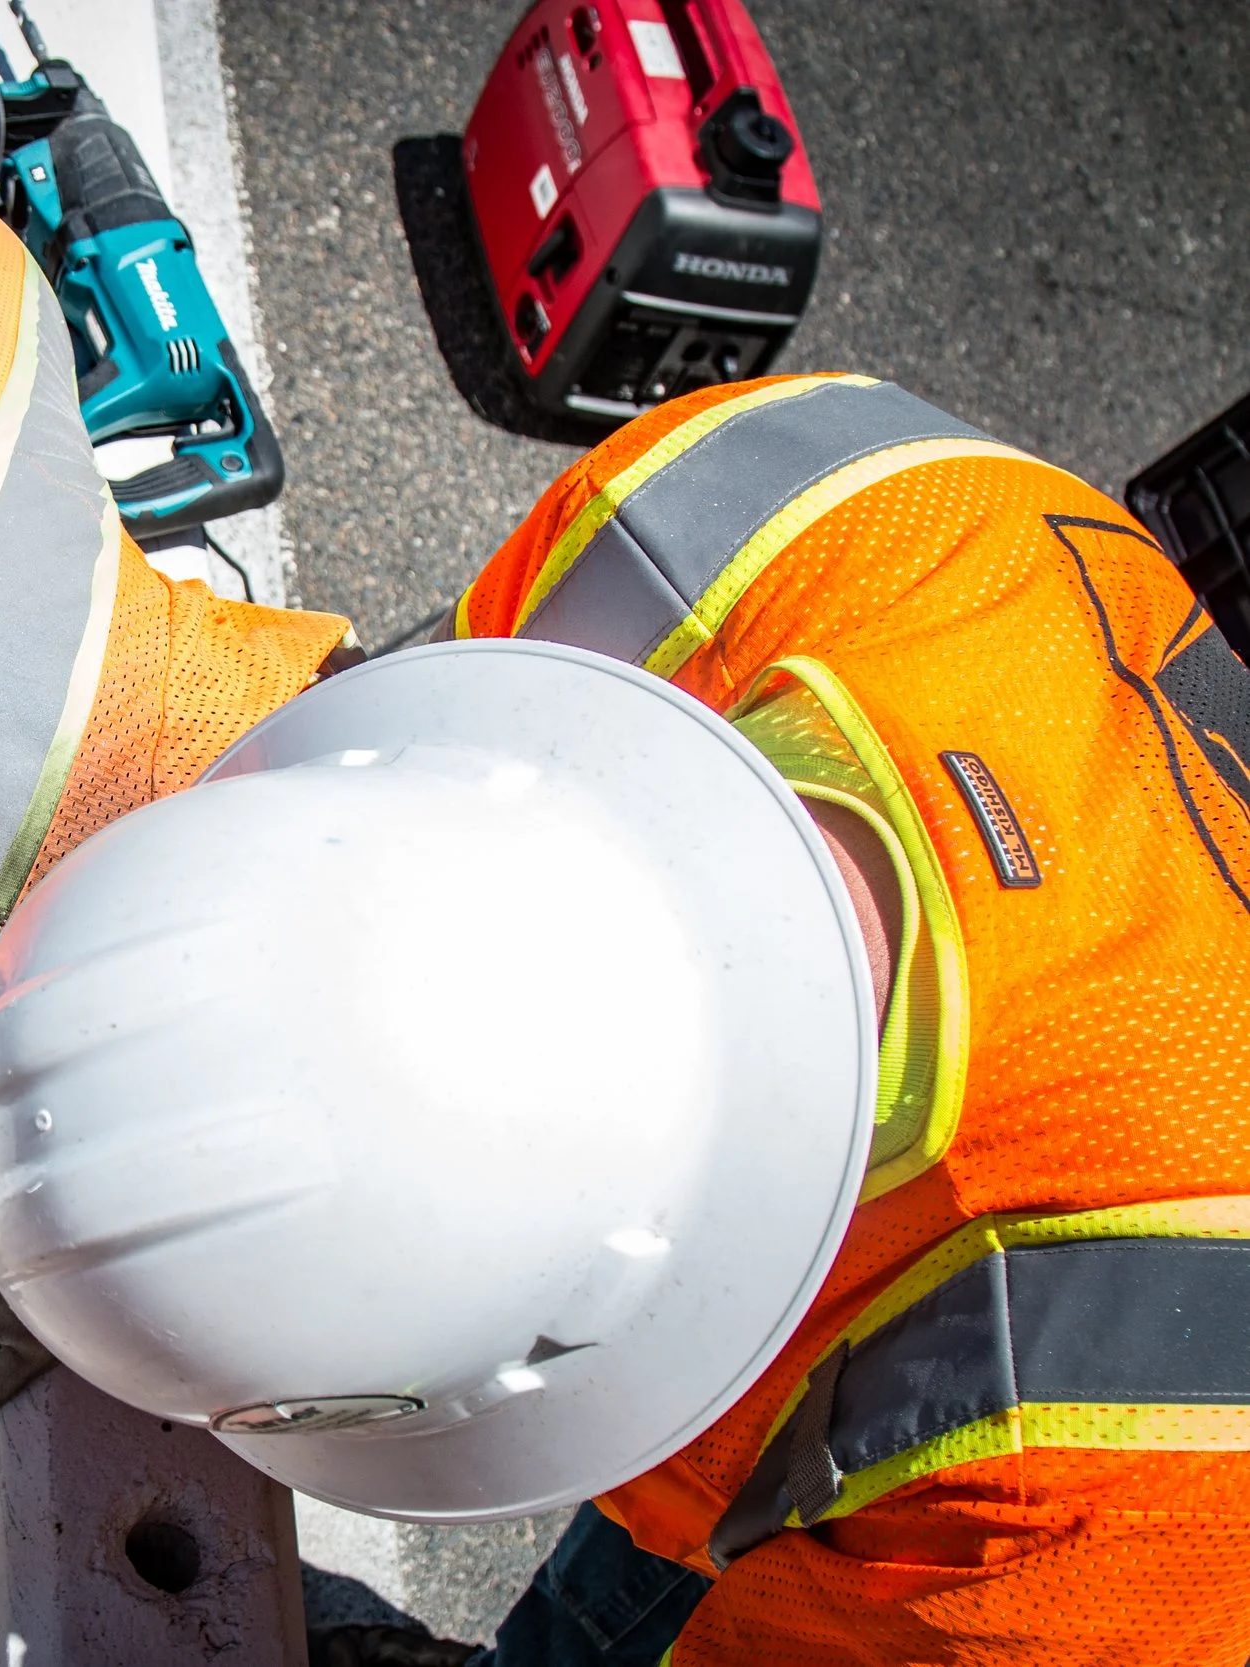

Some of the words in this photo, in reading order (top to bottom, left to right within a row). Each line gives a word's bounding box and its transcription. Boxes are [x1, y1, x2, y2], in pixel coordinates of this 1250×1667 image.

[671, 252, 793, 287] HONDA
[969, 761, 1015, 836] KISHIGO
[1002, 843, 1017, 870] THE
[1012, 844, 1030, 871] ML
